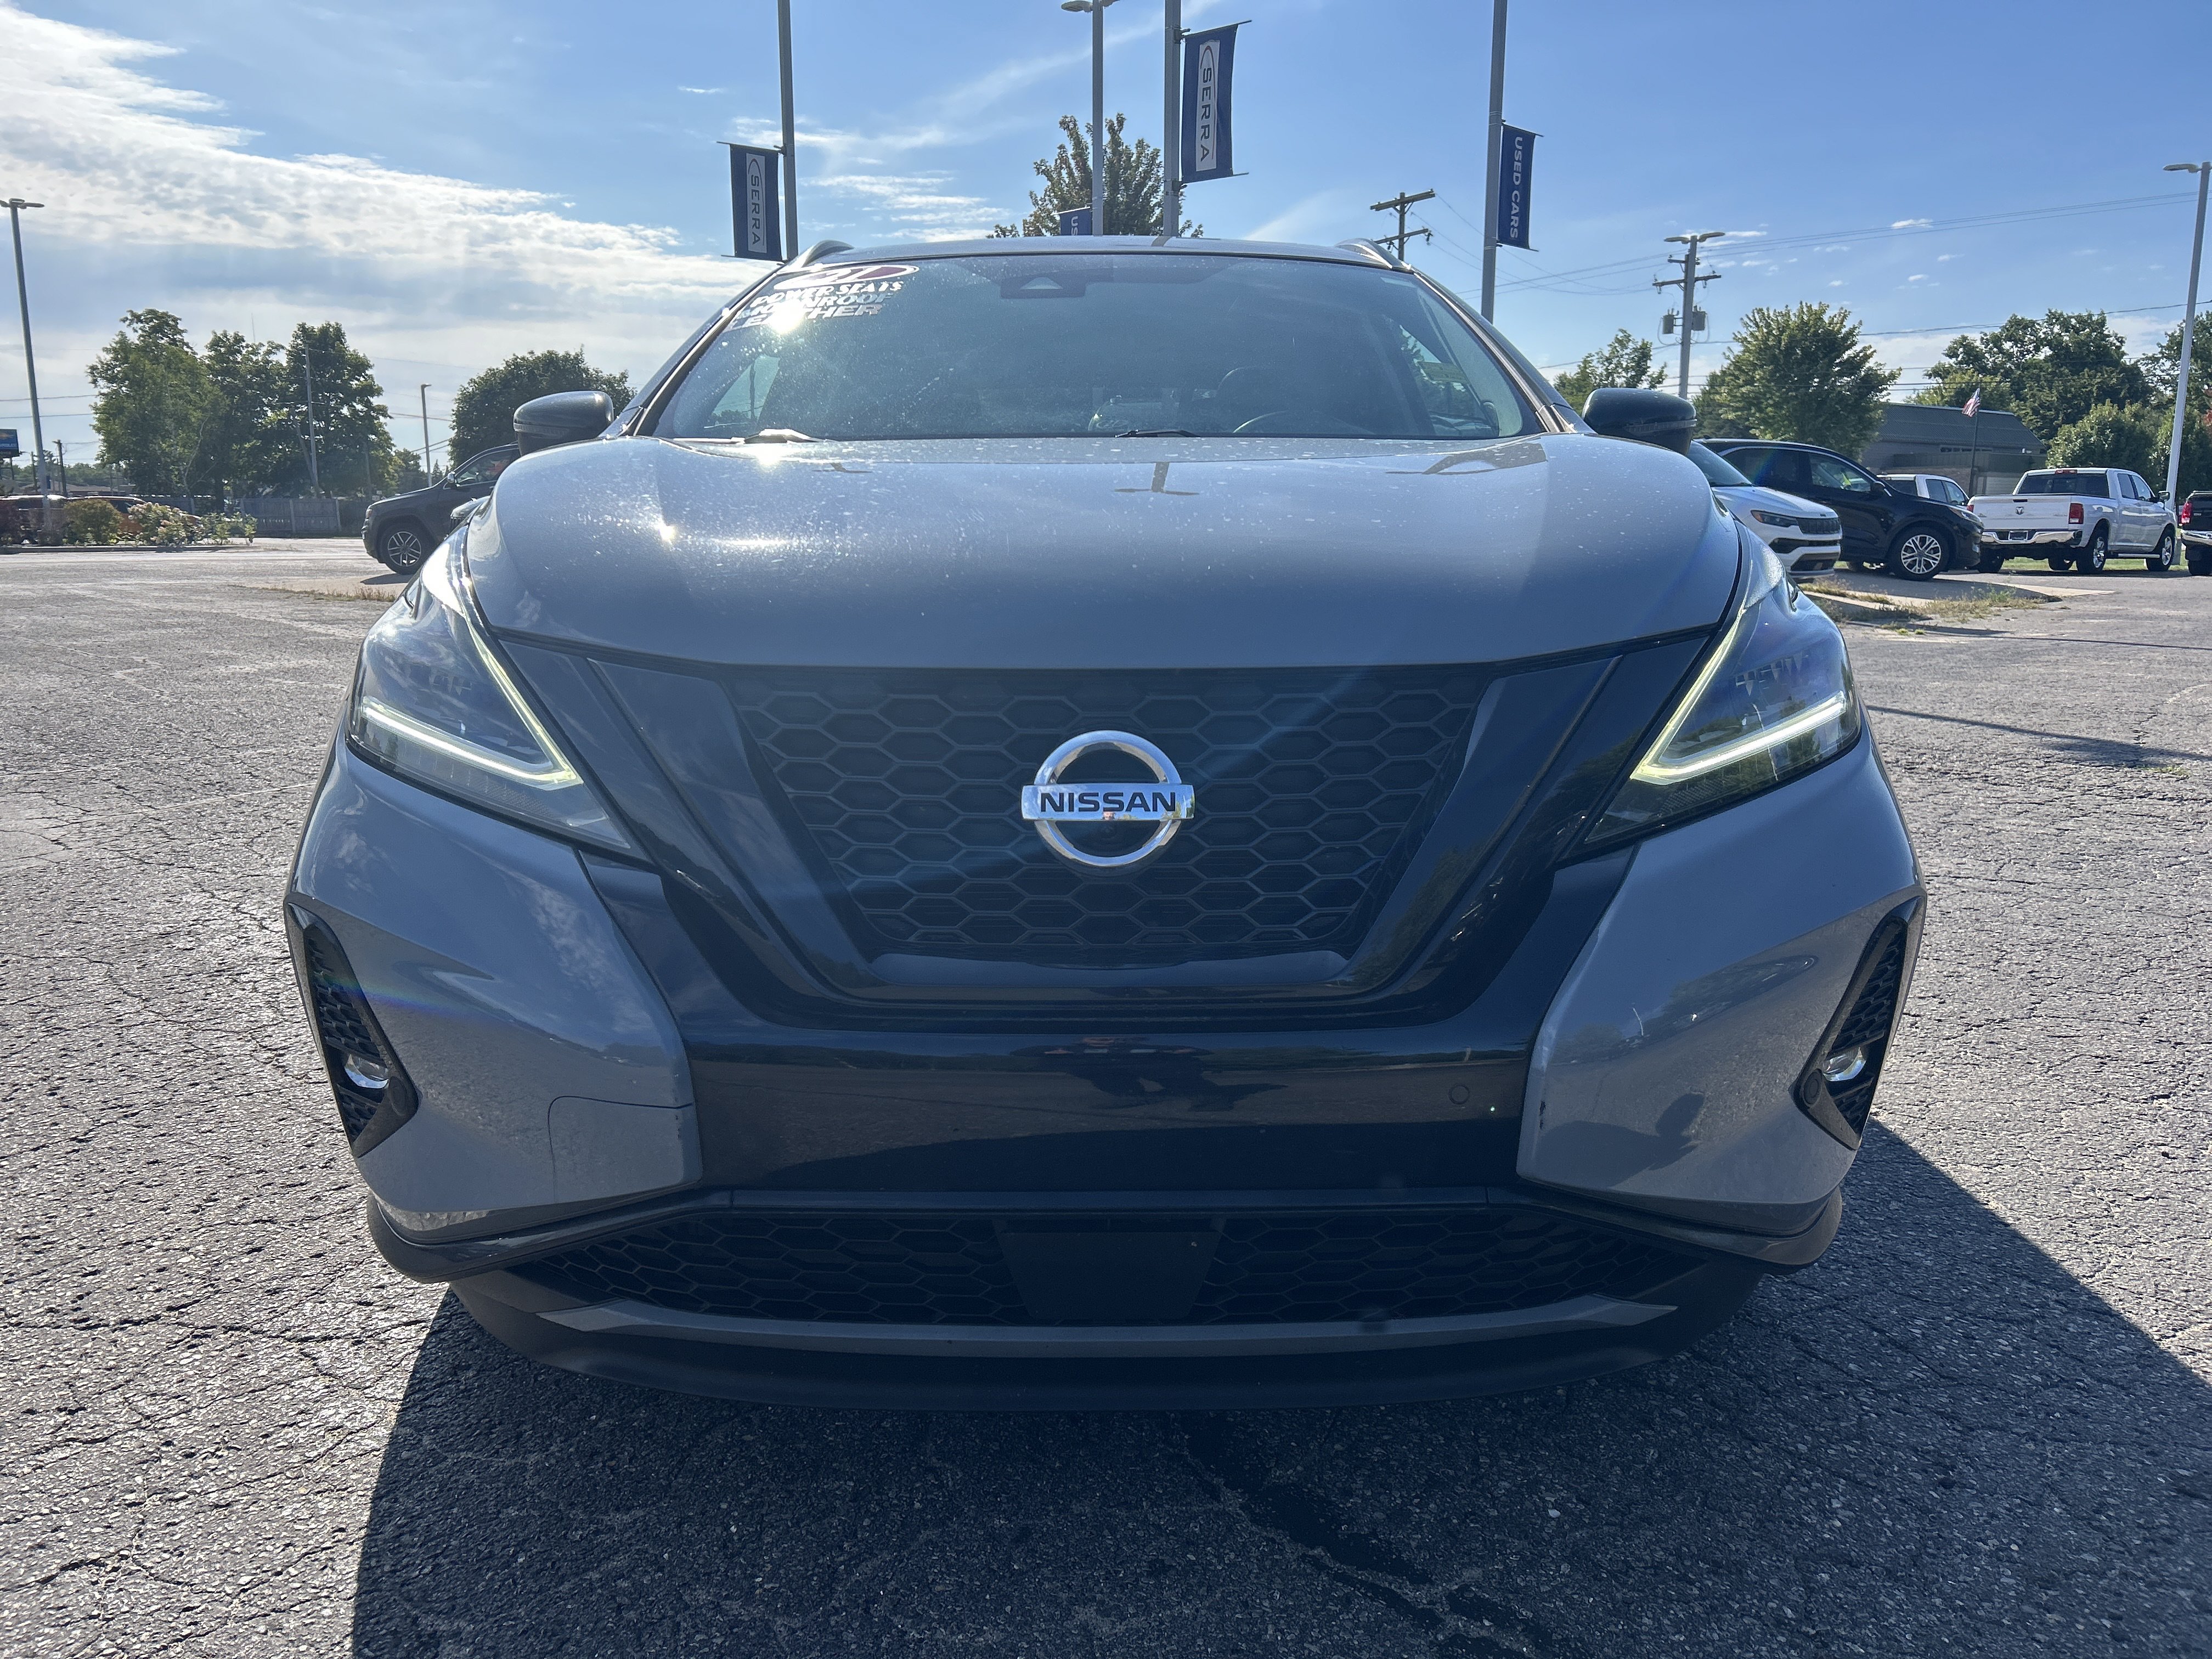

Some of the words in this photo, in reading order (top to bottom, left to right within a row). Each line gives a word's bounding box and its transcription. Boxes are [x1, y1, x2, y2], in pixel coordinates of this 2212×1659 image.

[1199, 67, 1212, 162] SERRA
[1513, 137, 1523, 185] USED
[751, 175, 760, 245] SERRA
[1510, 190, 1520, 238] CARS
[750, 286, 834, 307] POWER
[836, 281, 904, 295] SEATS
[1041, 792, 1176, 812] NISSAN
